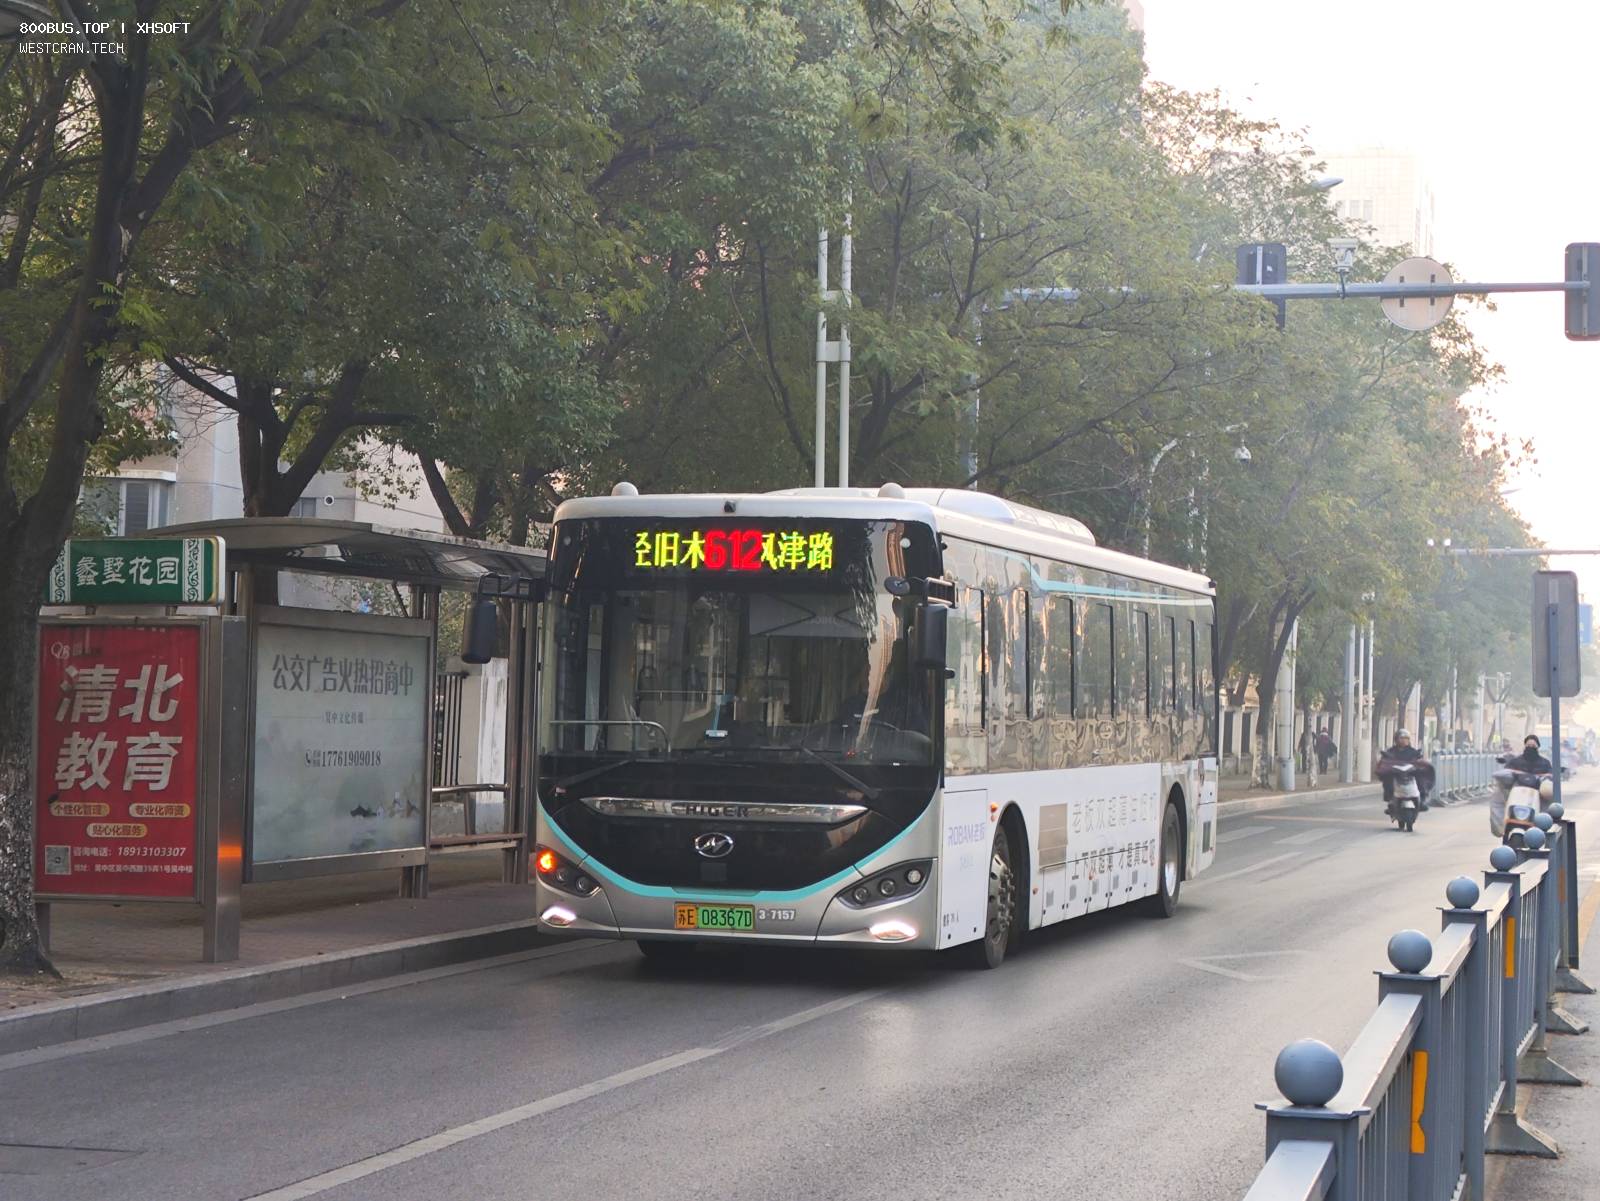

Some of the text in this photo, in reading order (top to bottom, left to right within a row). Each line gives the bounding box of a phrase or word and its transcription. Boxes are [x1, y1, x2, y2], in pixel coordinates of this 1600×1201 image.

[704, 530, 762, 570] 612
[75, 556, 179, 586] 蠡墅花园
[272, 654, 414, 696] 公交广告火热招商中
[55, 664, 184, 723] 清北
[54, 731, 183, 791] 教育
[322, 751, 382, 767] 17761909018
[118, 846, 187, 857] 18913103307
[678, 909, 753, 927] 苏E 08367D
